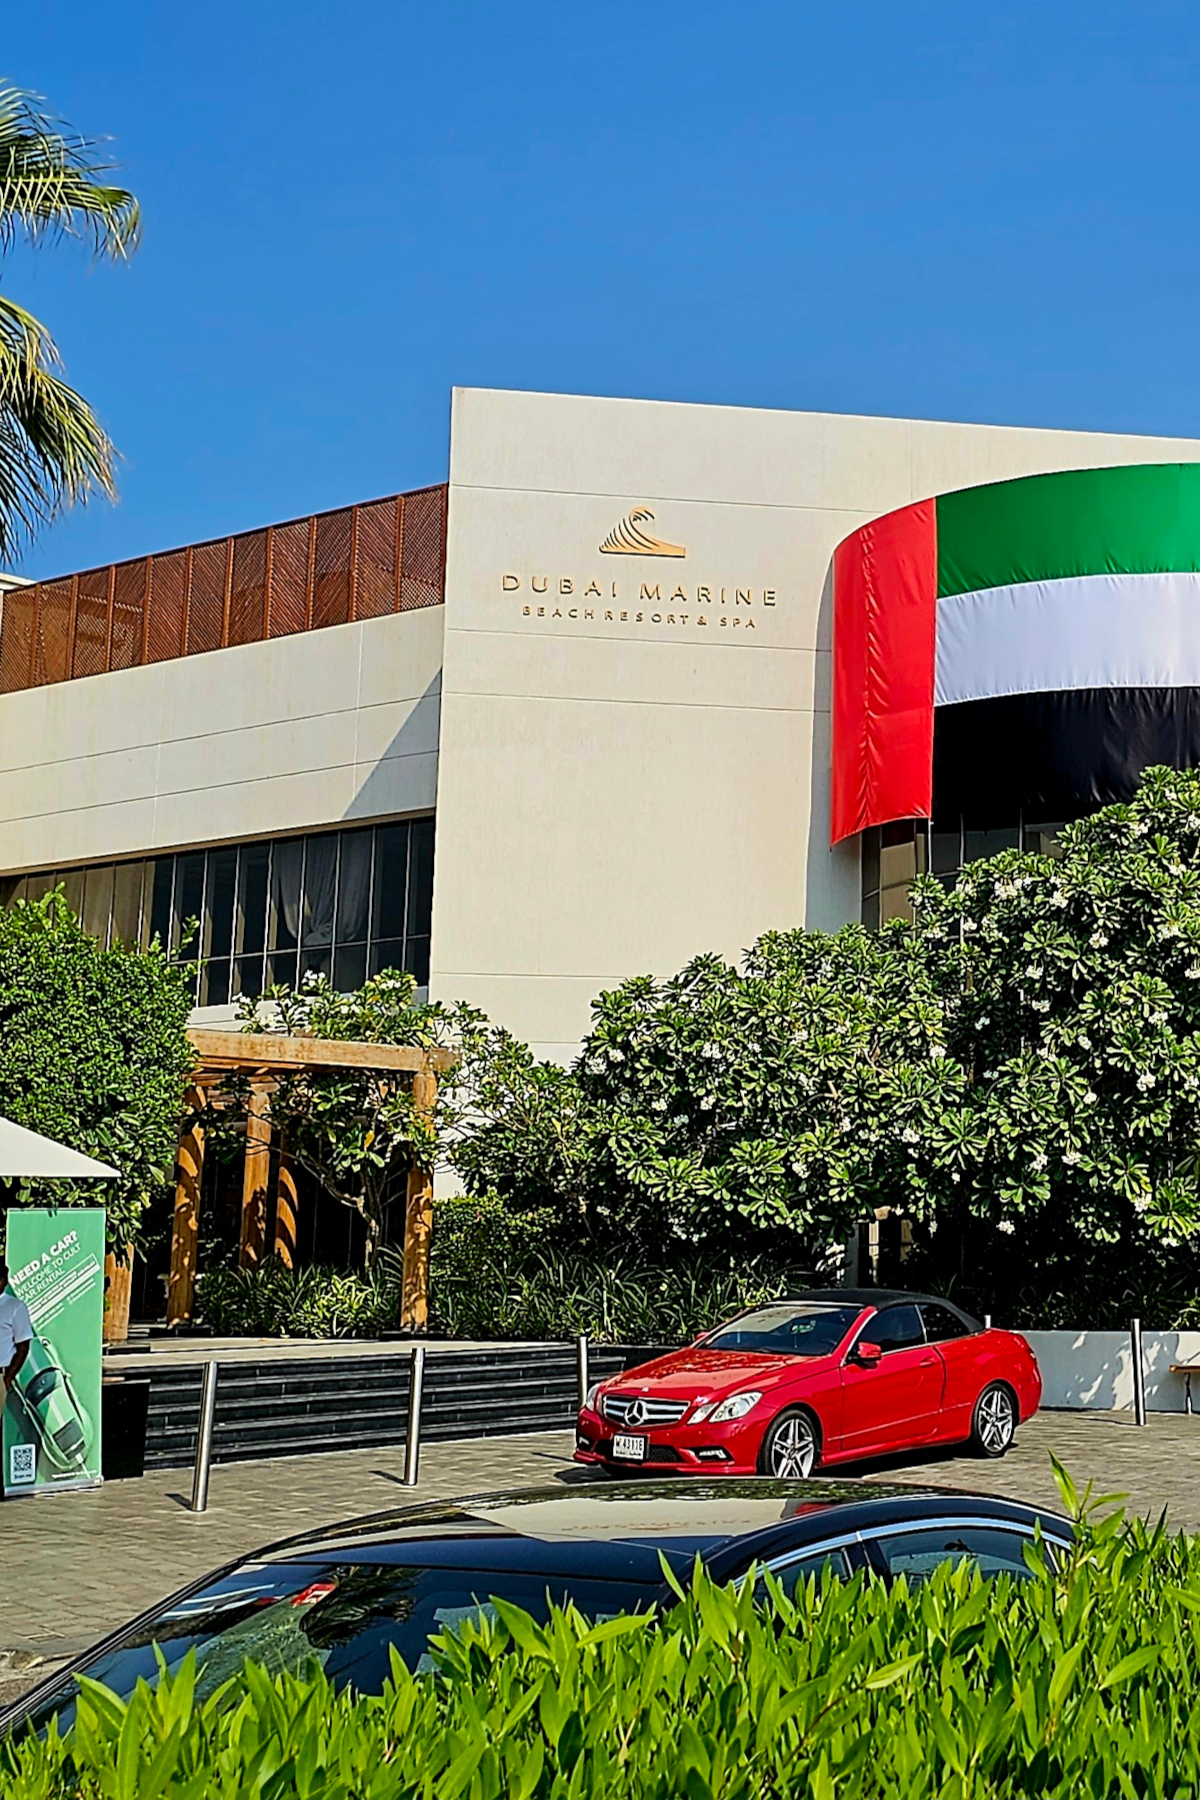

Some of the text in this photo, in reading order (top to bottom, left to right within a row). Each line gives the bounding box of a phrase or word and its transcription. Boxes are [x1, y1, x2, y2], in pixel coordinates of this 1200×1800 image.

[502, 575, 777, 607] DUBAI MARINE
[522, 605, 756, 629] BEACH RESORT & SPA
[8, 1230, 78, 1288] NEED A CAR?
[16, 1265, 53, 1296] WELCOME
[51, 1257, 64, 1268] TO
[63, 1243, 81, 1260] CULT
[36, 1268, 65, 1291] RENTAL
